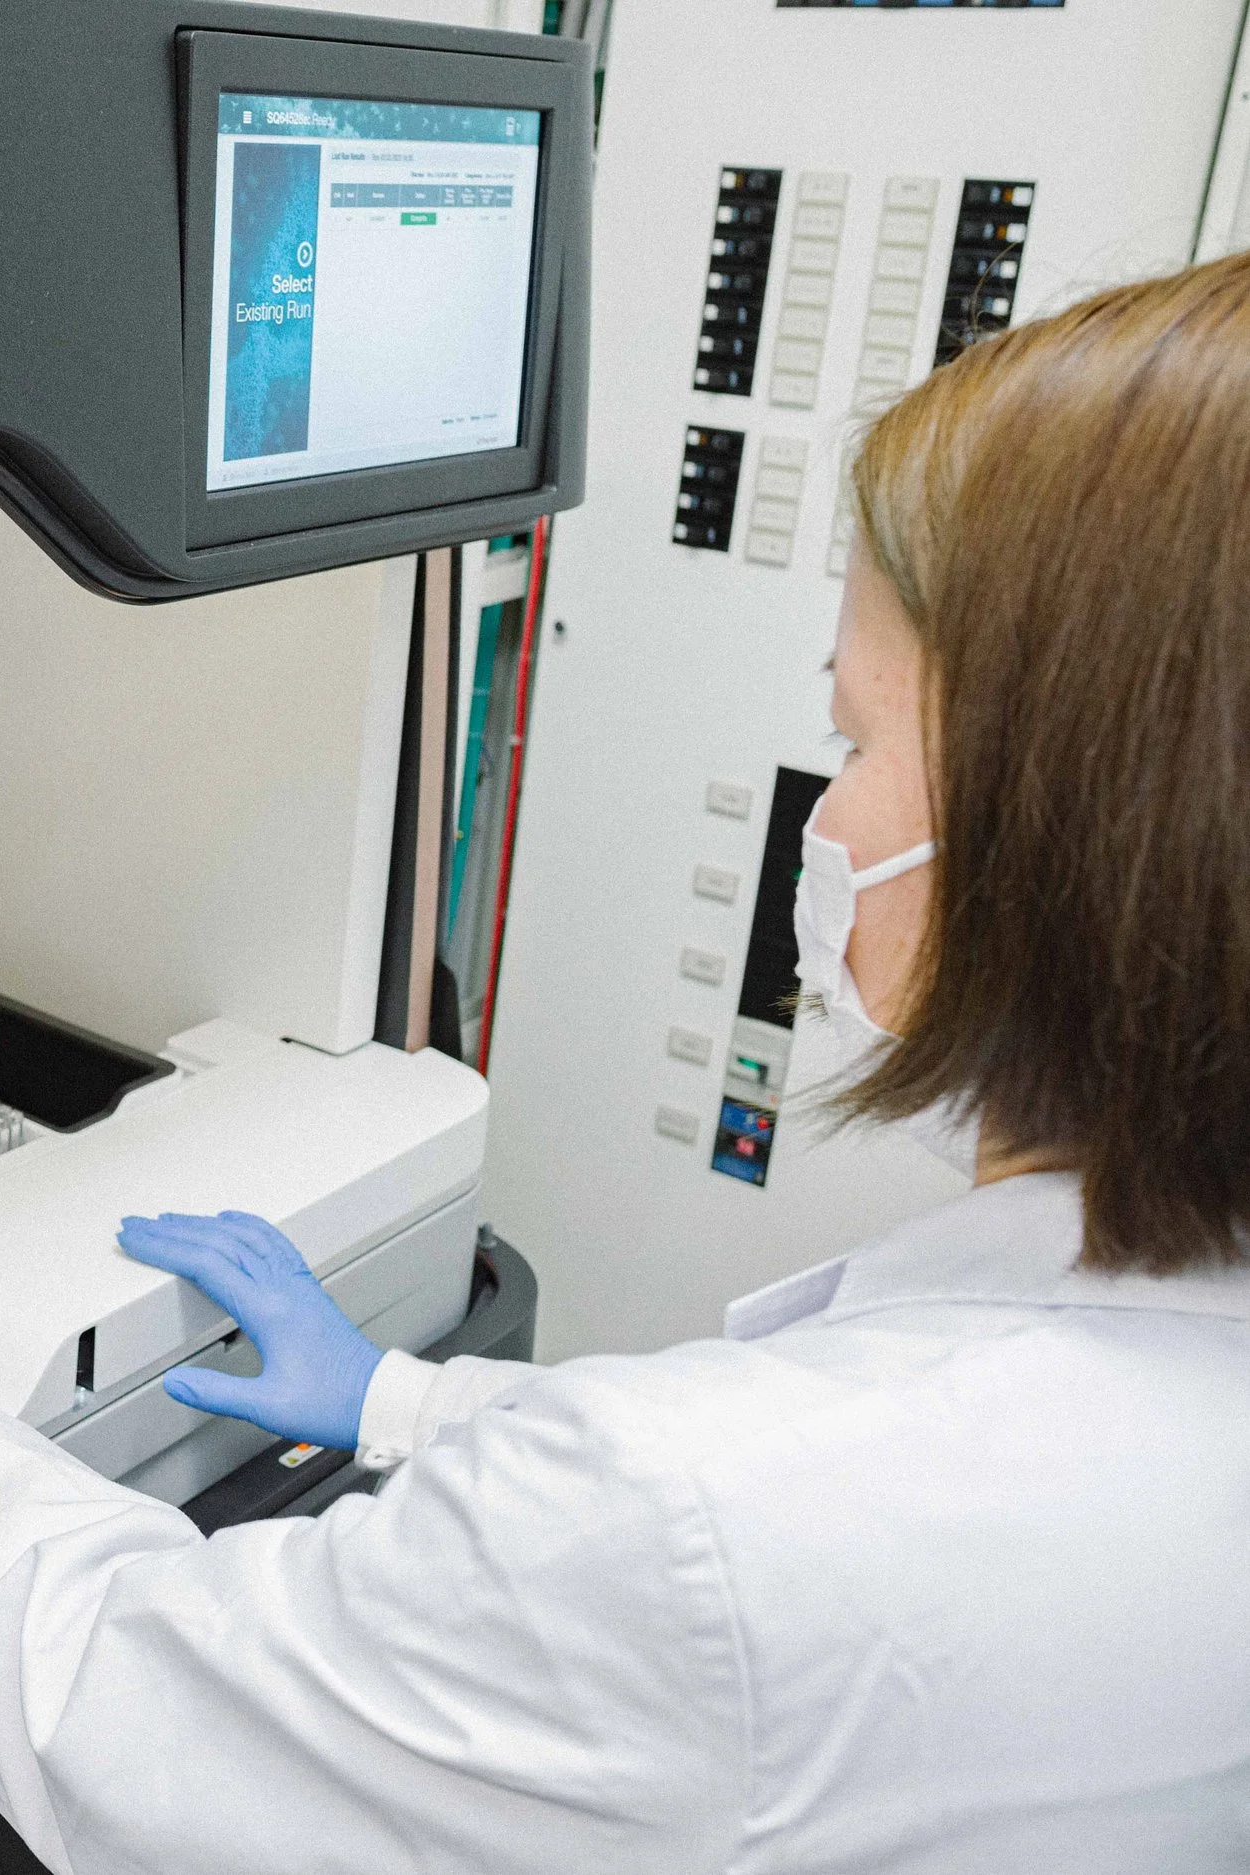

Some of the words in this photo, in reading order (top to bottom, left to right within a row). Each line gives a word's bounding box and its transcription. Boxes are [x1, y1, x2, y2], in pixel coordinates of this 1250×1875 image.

[312, 113, 336, 129] Ready
[272, 274, 313, 294] Select
[236, 302, 284, 325] Existing
[287, 300, 311, 319] Run
